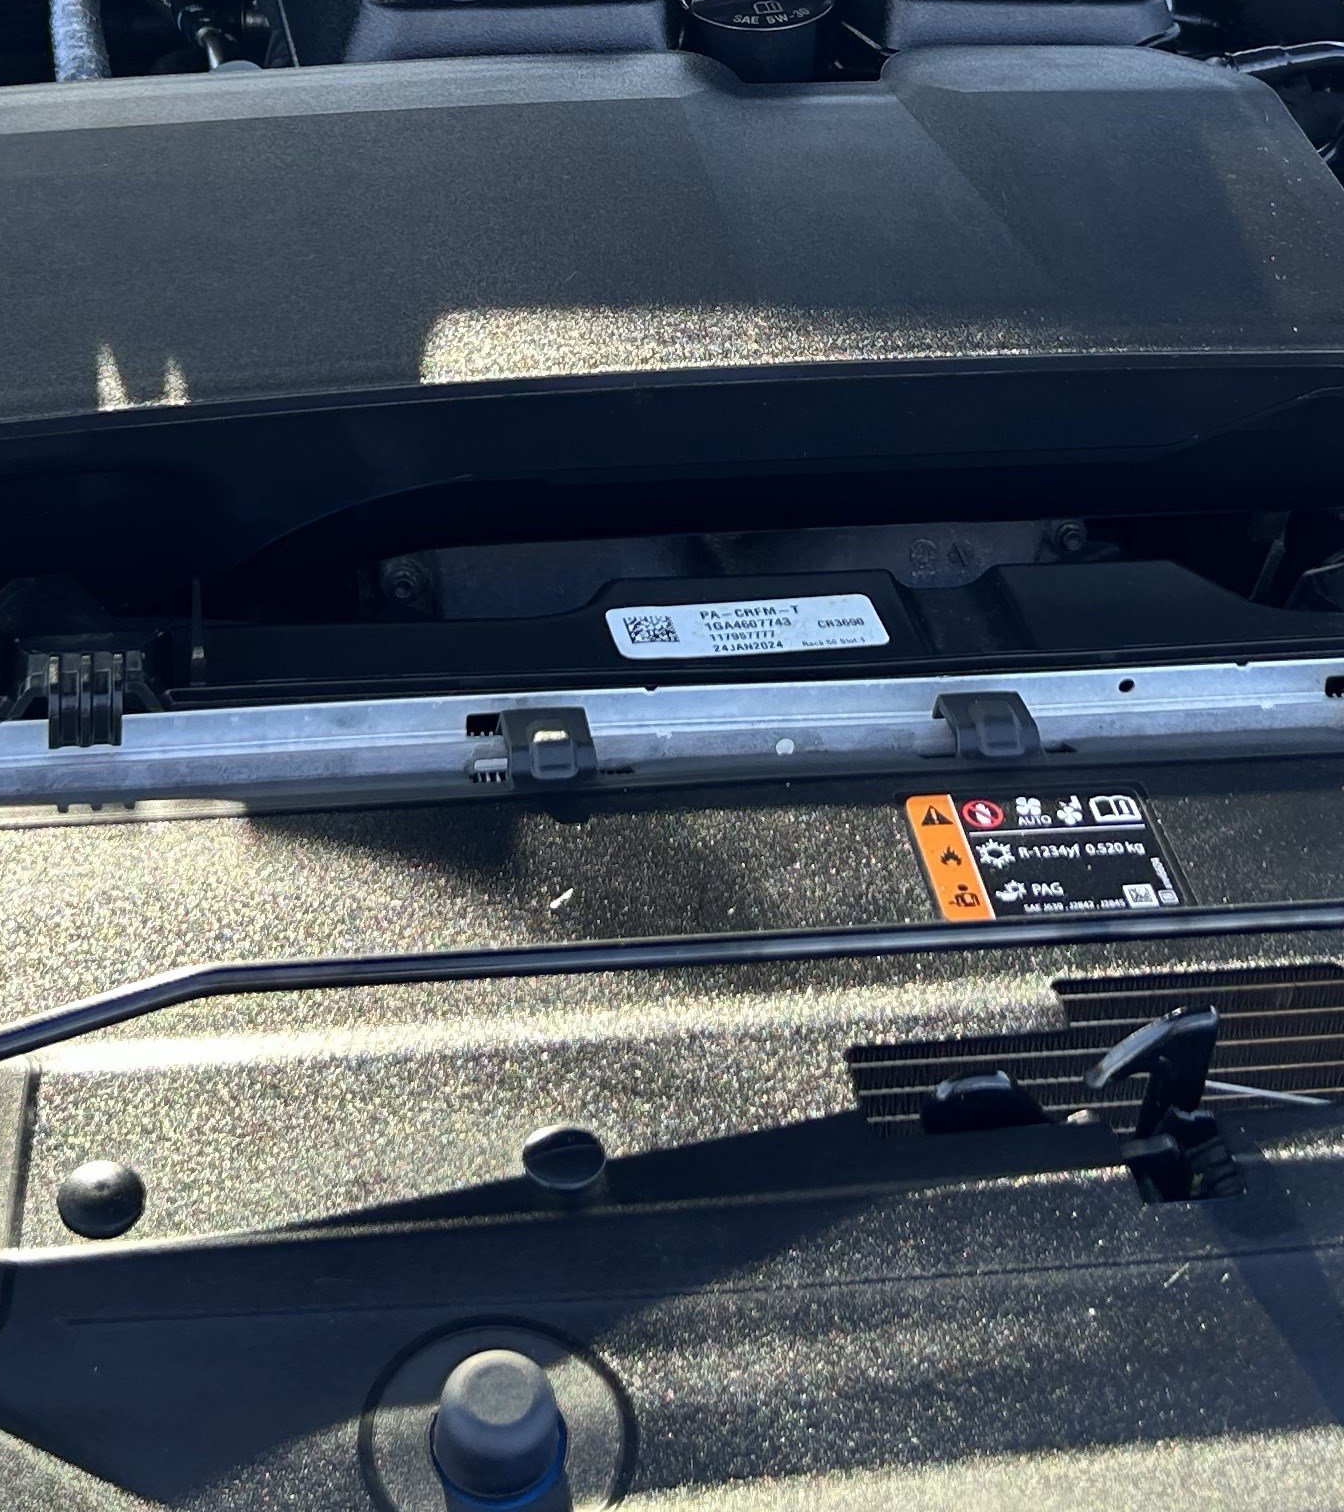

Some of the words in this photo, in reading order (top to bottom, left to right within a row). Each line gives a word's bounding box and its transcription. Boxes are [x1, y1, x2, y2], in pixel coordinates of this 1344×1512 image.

[732, 14, 759, 25] SAE
[712, 640, 784, 653] 24JAN2024
[1018, 814, 1053, 828] AUTO
[1018, 842, 1081, 860] R-1234yf
[1085, 841, 1125, 856] 0.520
[1125, 840, 1146, 857] kg
[1031, 881, 1065, 897] PAG
[1023, 902, 1042, 912] SAE
